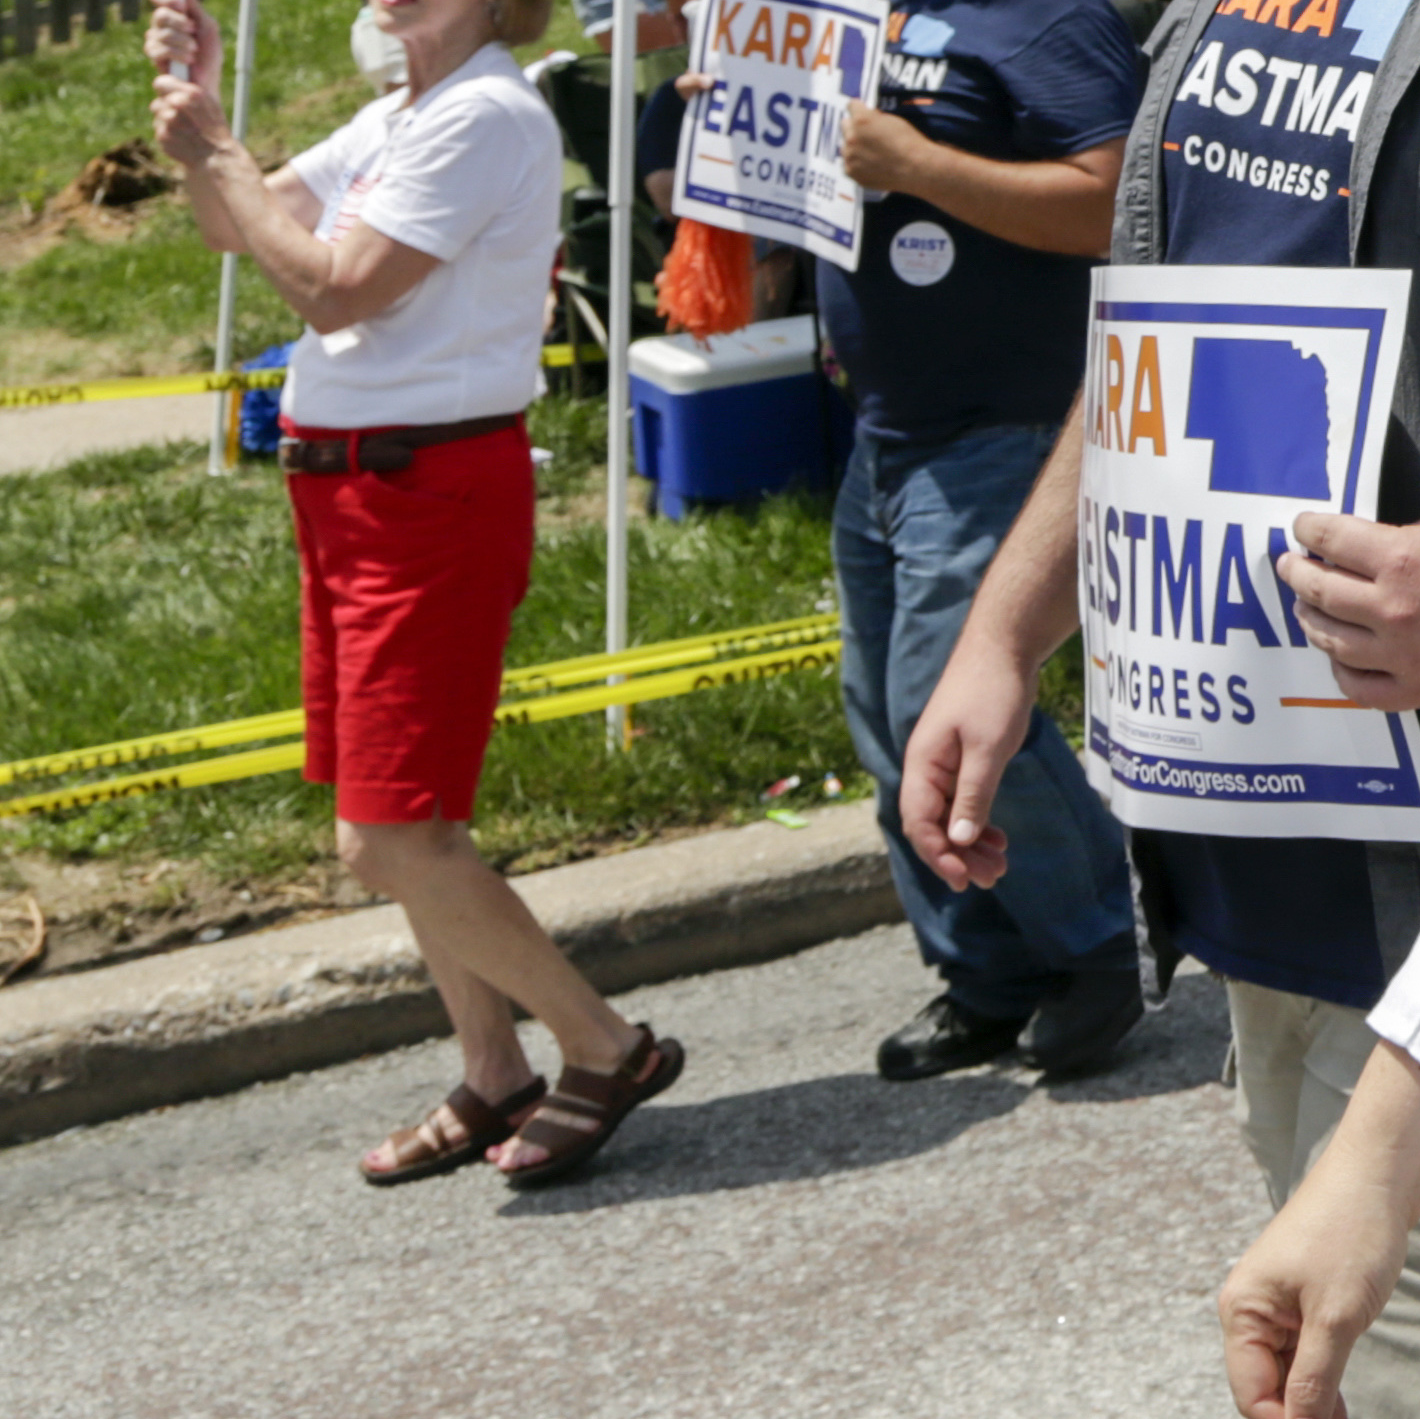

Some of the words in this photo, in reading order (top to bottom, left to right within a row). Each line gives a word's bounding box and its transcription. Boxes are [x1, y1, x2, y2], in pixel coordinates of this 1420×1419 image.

[705, 79, 844, 164] EASTM
[1176, 39, 1375, 143] ASTMA
[740, 155, 837, 202] CONGRESS
[1183, 134, 1331, 202] CONGRESS
[897, 236, 947, 252] KRIST
